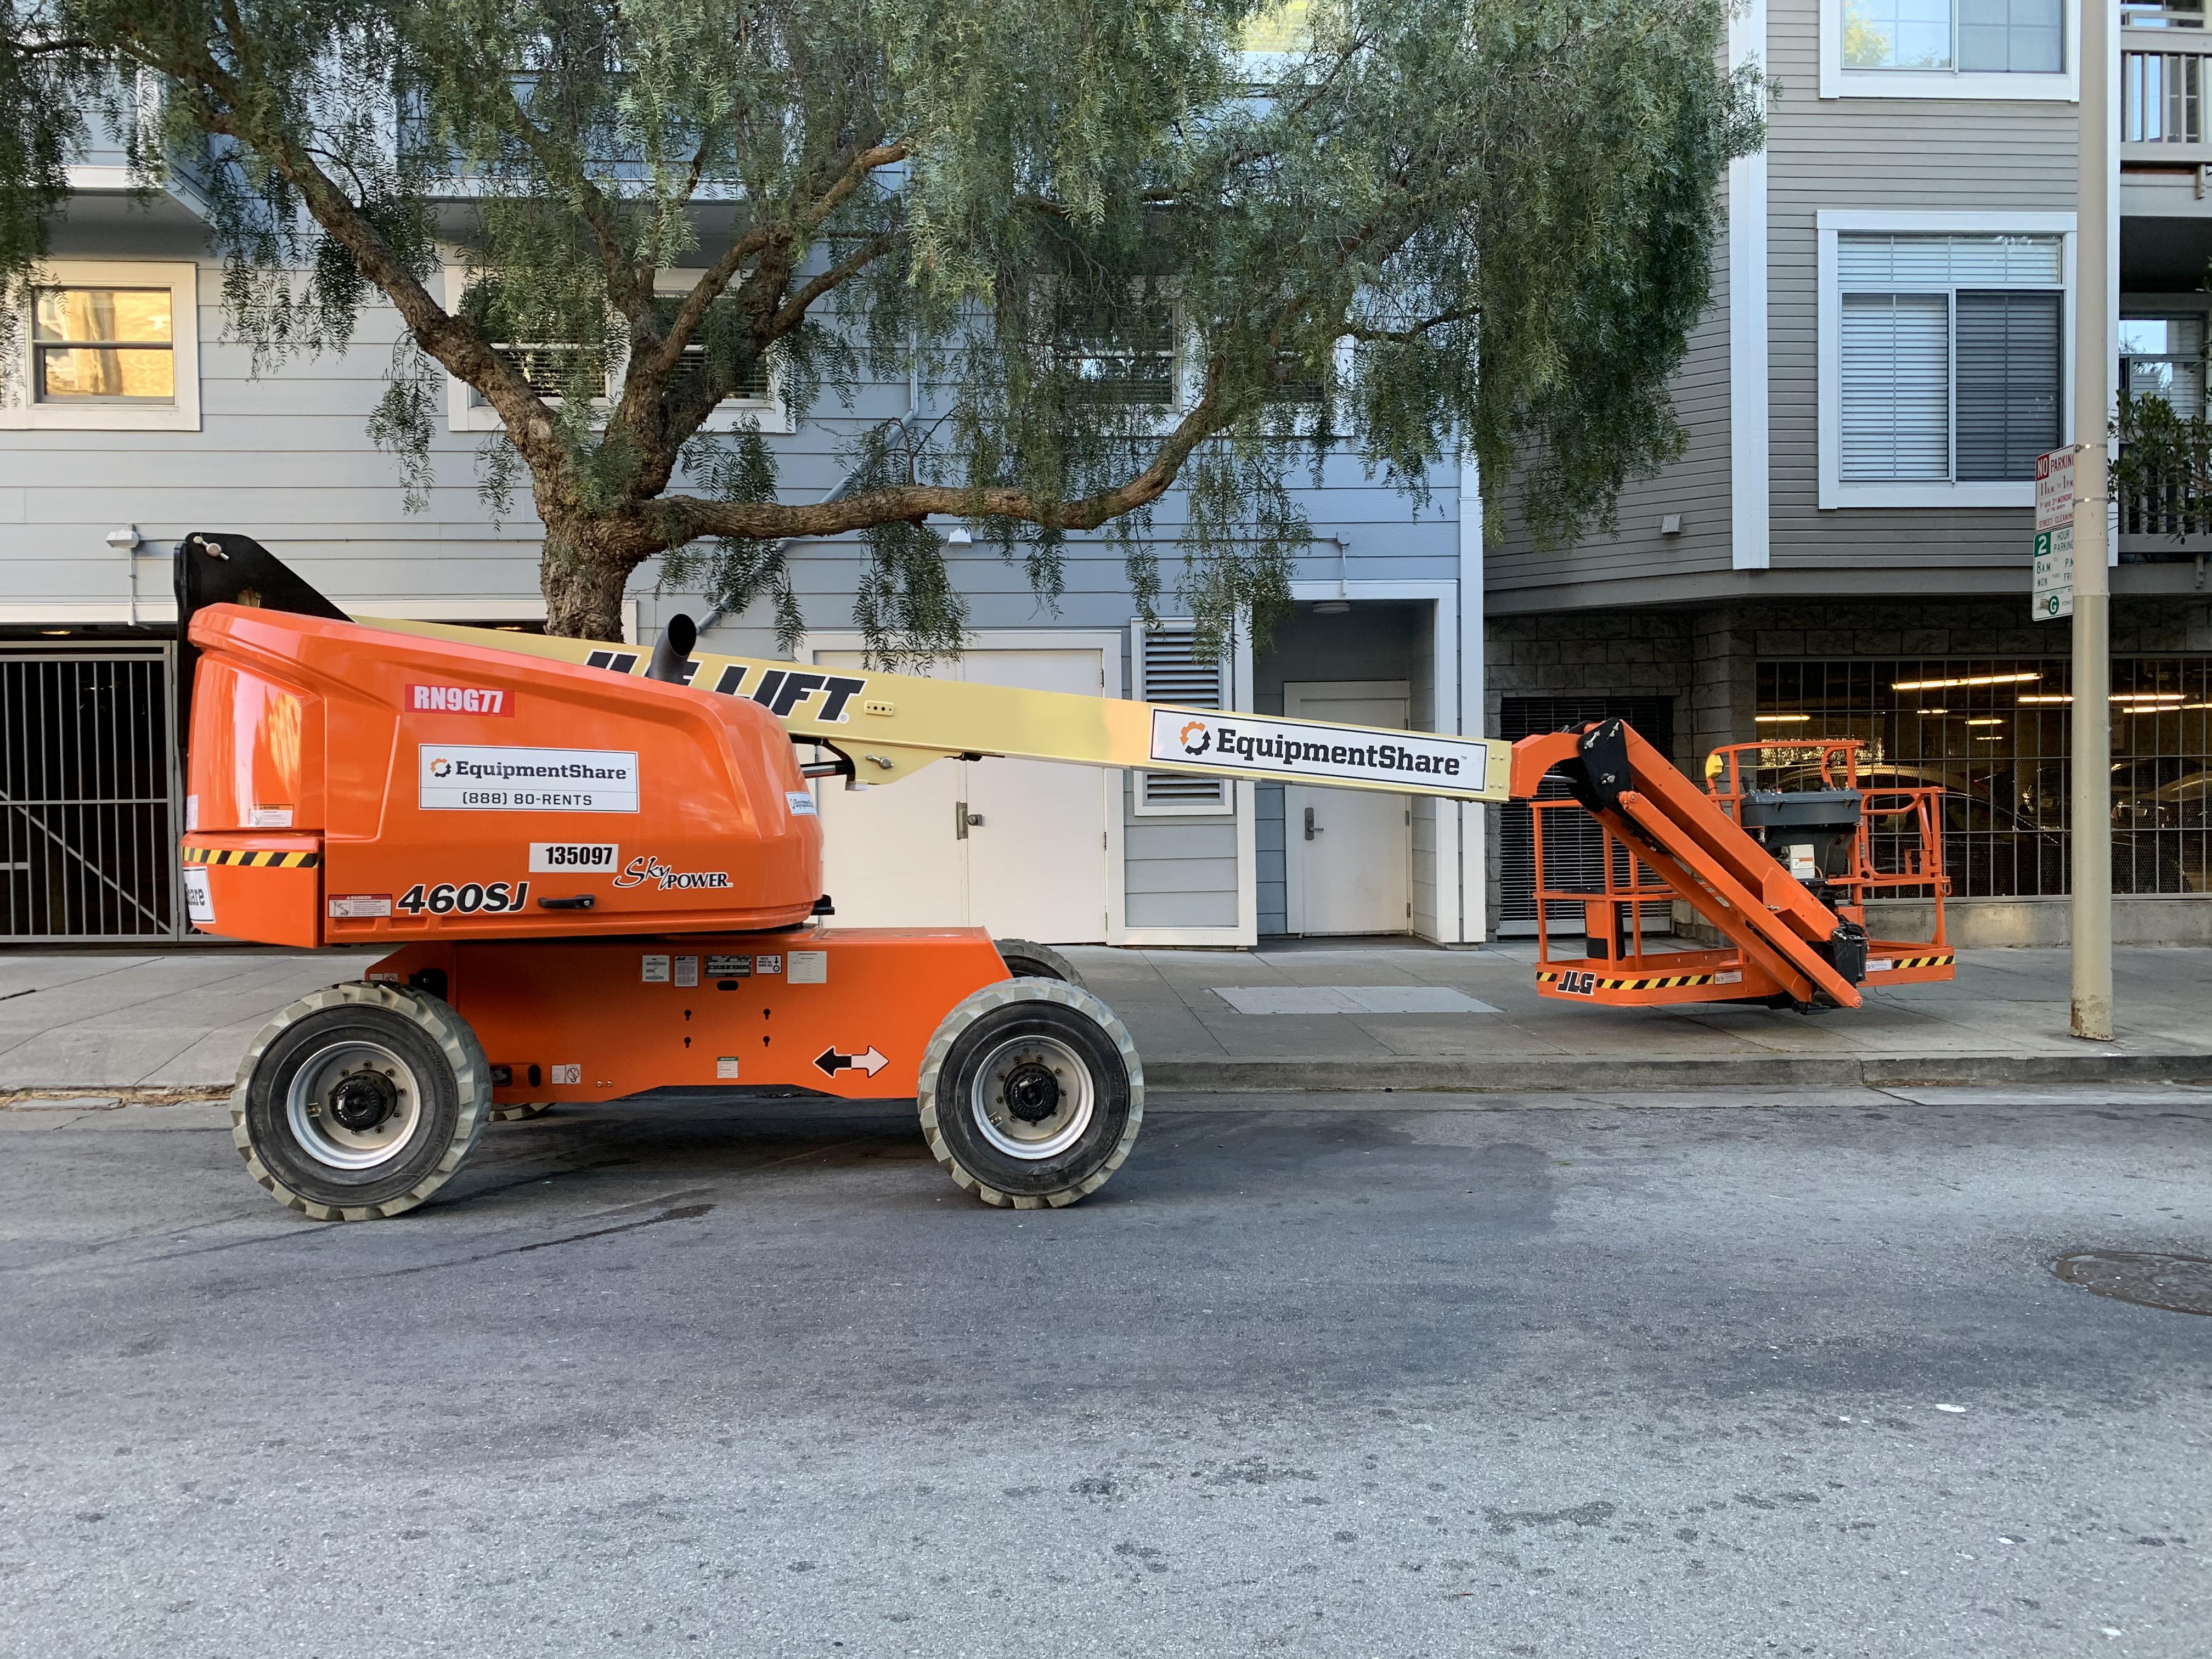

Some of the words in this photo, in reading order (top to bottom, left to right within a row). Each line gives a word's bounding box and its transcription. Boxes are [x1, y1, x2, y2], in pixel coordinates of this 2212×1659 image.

[2038, 457, 2048, 478] NO
[2057, 493, 2072, 503] MONDAY
[2039, 517, 2052, 528] STREET
[2038, 535, 2047, 555] 2
[2057, 529, 2069, 541] HOUR
[2037, 577, 2047, 587] MON
[2064, 572, 2072, 582] FRI
[2050, 598, 2057, 613] G
[414, 686, 503, 713] RN9G77
[1216, 727, 1460, 775] EquipmentShare
[456, 761, 627, 780] EquipmentShare
[462, 792, 507, 805] (888)
[514, 793, 592, 805] 80-RENTS
[545, 847, 612, 865] 135097
[397, 882, 528, 915] 460SJ
[1557, 970, 1595, 995] JLG
